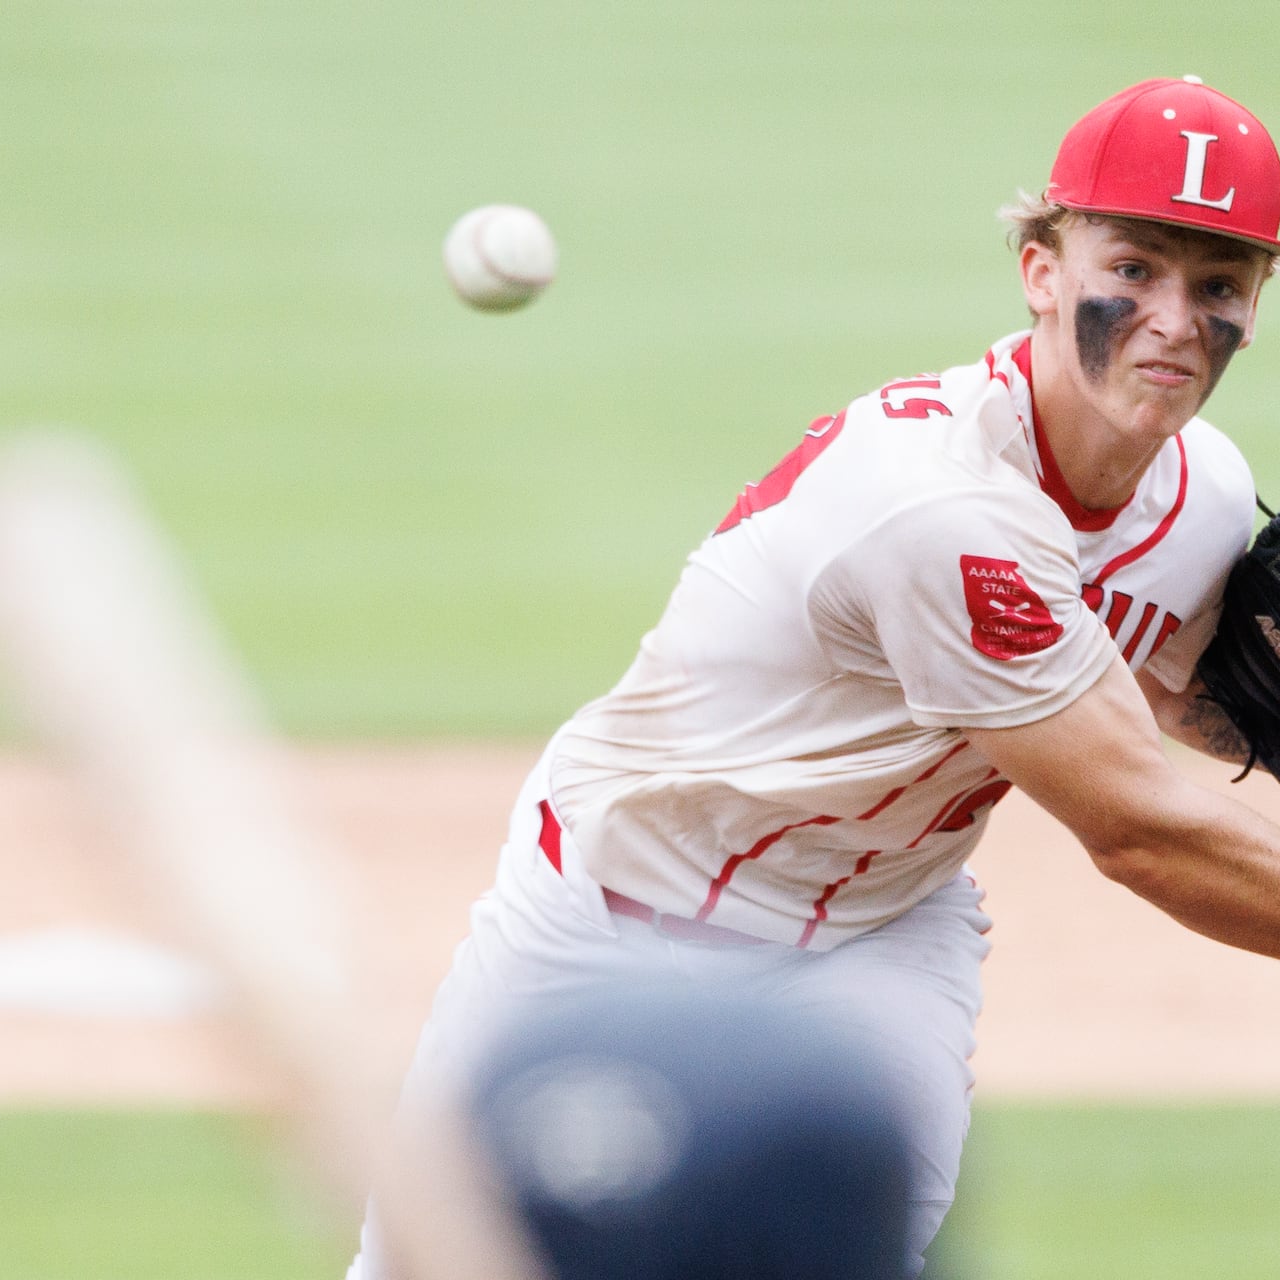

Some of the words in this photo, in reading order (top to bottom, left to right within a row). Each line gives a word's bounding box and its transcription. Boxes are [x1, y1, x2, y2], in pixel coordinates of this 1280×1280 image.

[1170, 130, 1236, 212] L
[969, 567, 1016, 582] AAAAA
[982, 583, 1021, 595] STATE
